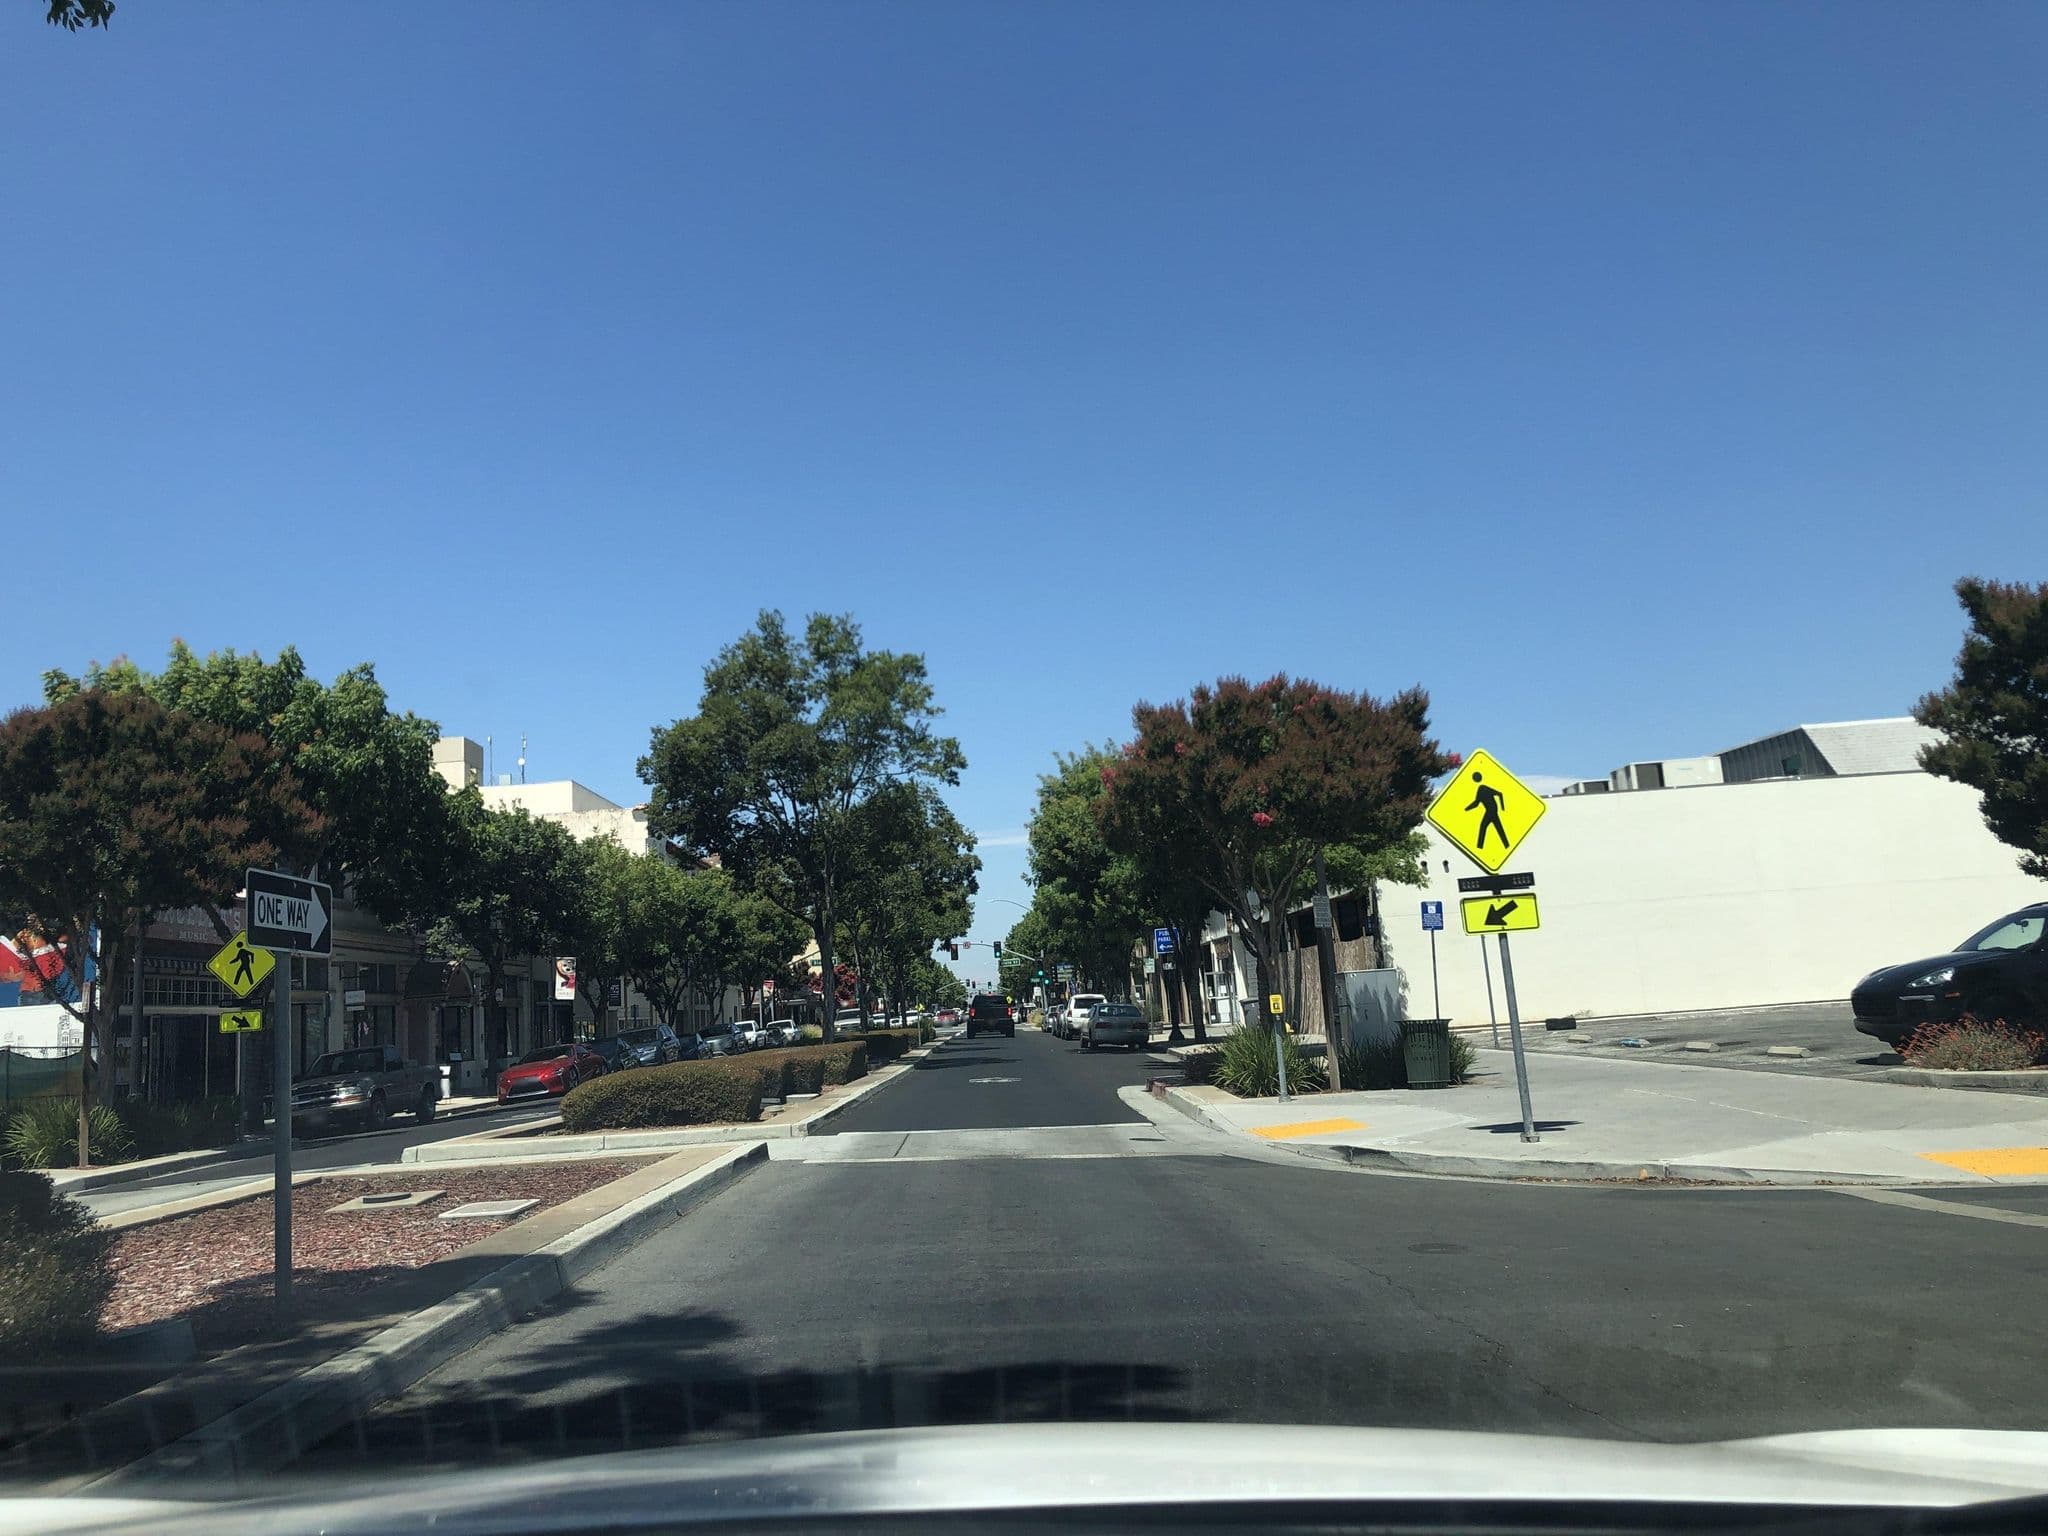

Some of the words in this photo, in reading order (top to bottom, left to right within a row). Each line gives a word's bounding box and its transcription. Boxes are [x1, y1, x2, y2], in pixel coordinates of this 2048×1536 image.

[257, 895, 283, 926] ONE
[286, 899, 310, 929] WAY
[178, 930, 208, 941] MUSIC
